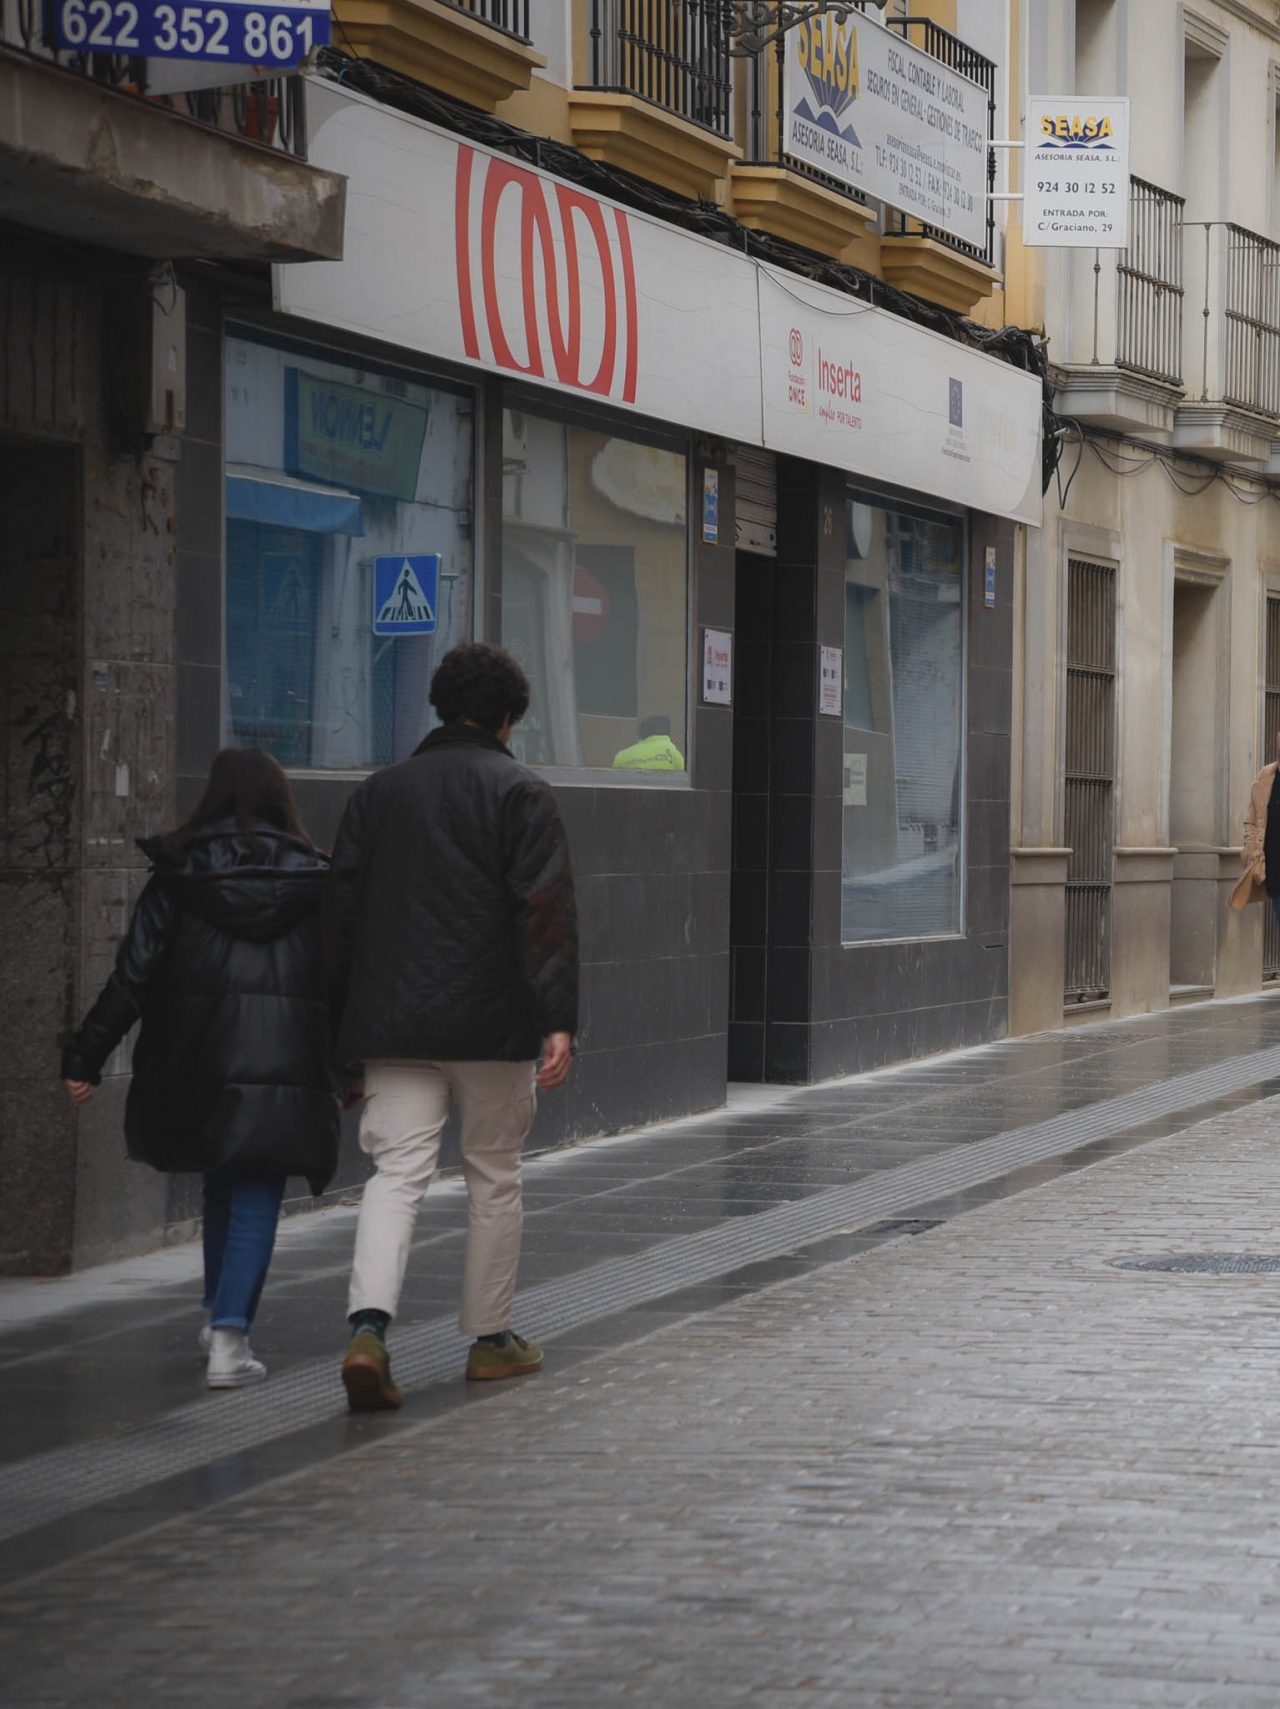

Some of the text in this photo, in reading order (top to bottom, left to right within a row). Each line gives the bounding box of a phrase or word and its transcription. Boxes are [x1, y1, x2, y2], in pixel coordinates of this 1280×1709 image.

[62, 0, 313, 60] 622 352 861
[797, 11, 861, 100] SEASA
[908, 61, 936, 96] CONTABLE
[941, 81, 965, 113] LABORAL
[867, 68, 891, 102] SEGUROS
[892, 83, 900, 108] EN
[901, 88, 924, 122] GENERAL
[927, 104, 954, 137] GESTIONES
[954, 119, 961, 142] DE
[962, 123, 983, 154] TRAFICO
[1040, 115, 1114, 137] SEASA
[792, 120, 825, 152] ASESORIA
[827, 137, 849, 170] SEASA,
[1035, 153, 1073, 161] ASESORIA
[1075, 154, 1102, 162] SEASA,
[889, 153, 899, 175] 924
[900, 158, 908, 179] 30
[1037, 181, 1116, 194] 924 30 12 52
[1043, 208, 1085, 217] ENTRADA
[1102, 223, 1113, 232] 29
[818, 346, 862, 404] Inserta
[788, 384, 805, 407] ONCE
[822, 505, 833, 535] 26
